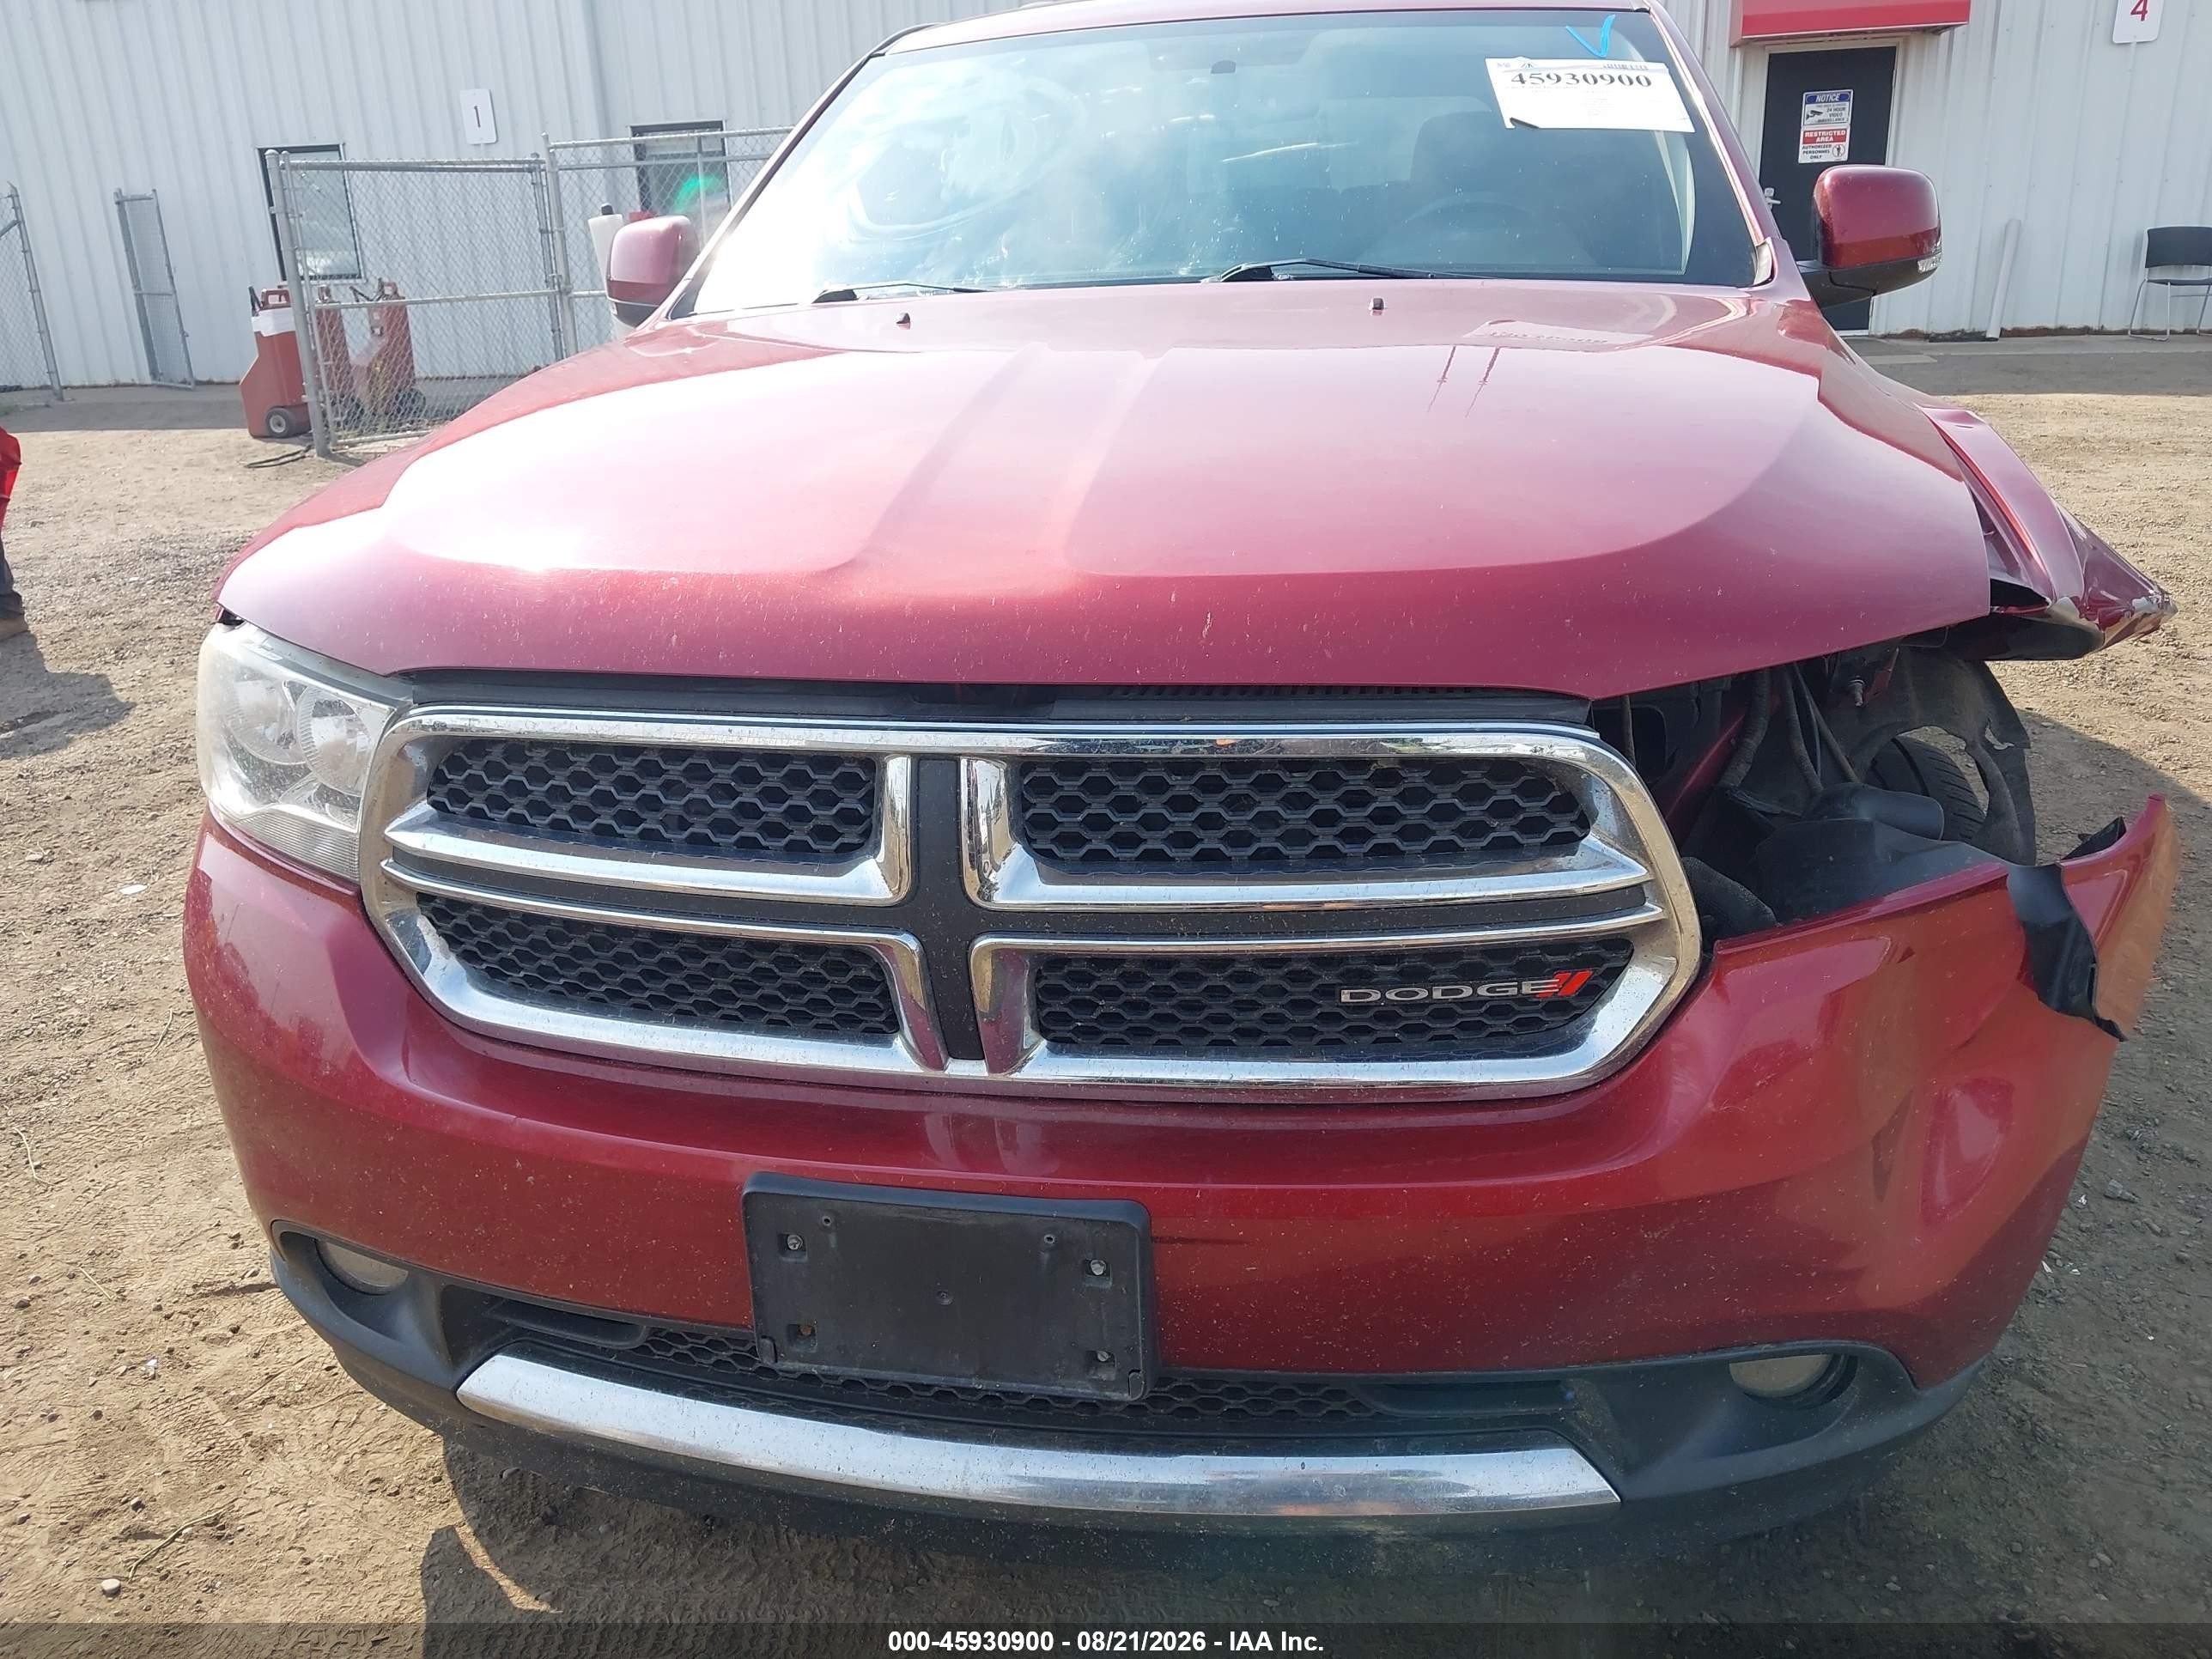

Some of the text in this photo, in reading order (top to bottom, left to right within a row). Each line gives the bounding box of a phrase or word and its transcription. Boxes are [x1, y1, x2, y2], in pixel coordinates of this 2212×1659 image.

[2130, 0, 2148, 21] 4
[1510, 72, 1652, 88] 45930900
[1815, 94, 1841, 102] NOTICE
[473, 105, 481, 128] 1
[1340, 979, 1560, 1003] DODGE
